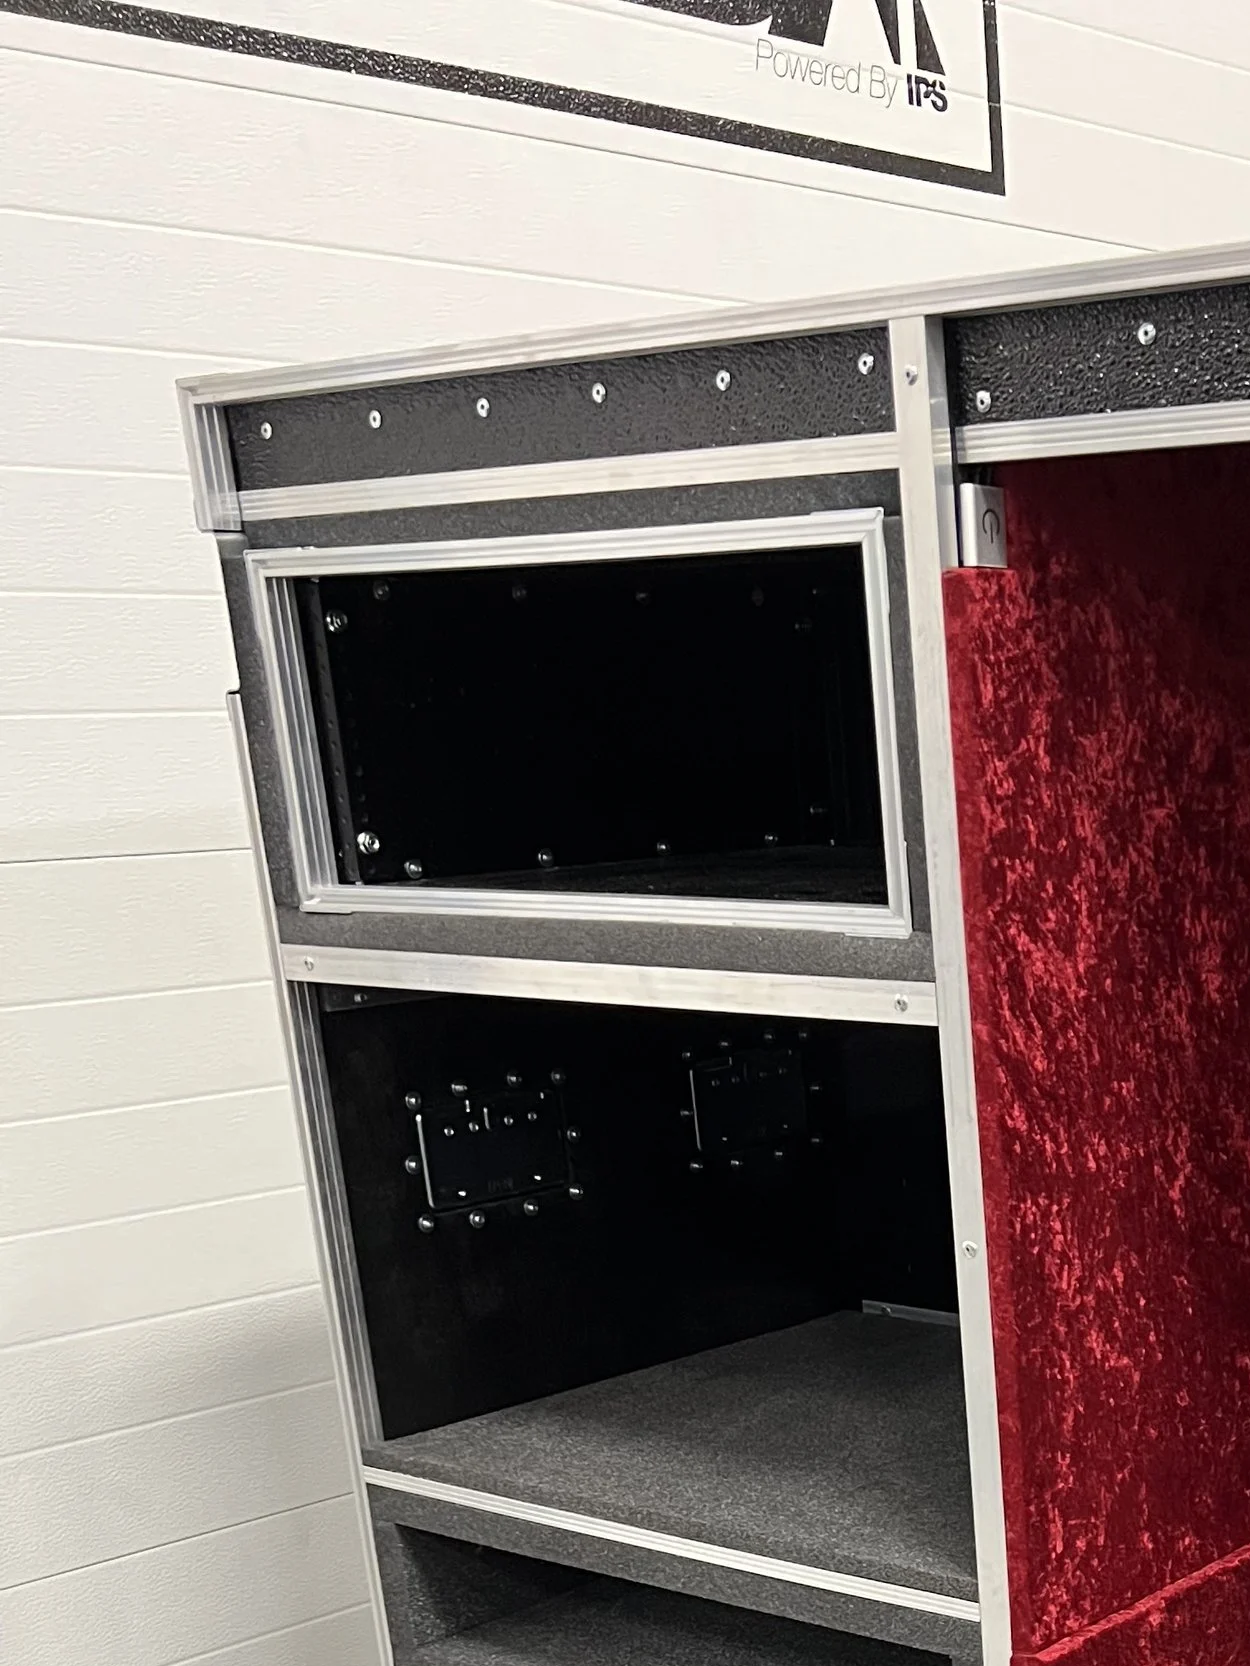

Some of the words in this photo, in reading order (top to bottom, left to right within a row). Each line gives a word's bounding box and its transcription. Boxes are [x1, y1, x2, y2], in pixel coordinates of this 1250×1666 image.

[756, 38, 861, 93] Powered
[869, 64, 898, 108] By
[906, 73, 948, 112] IPS
